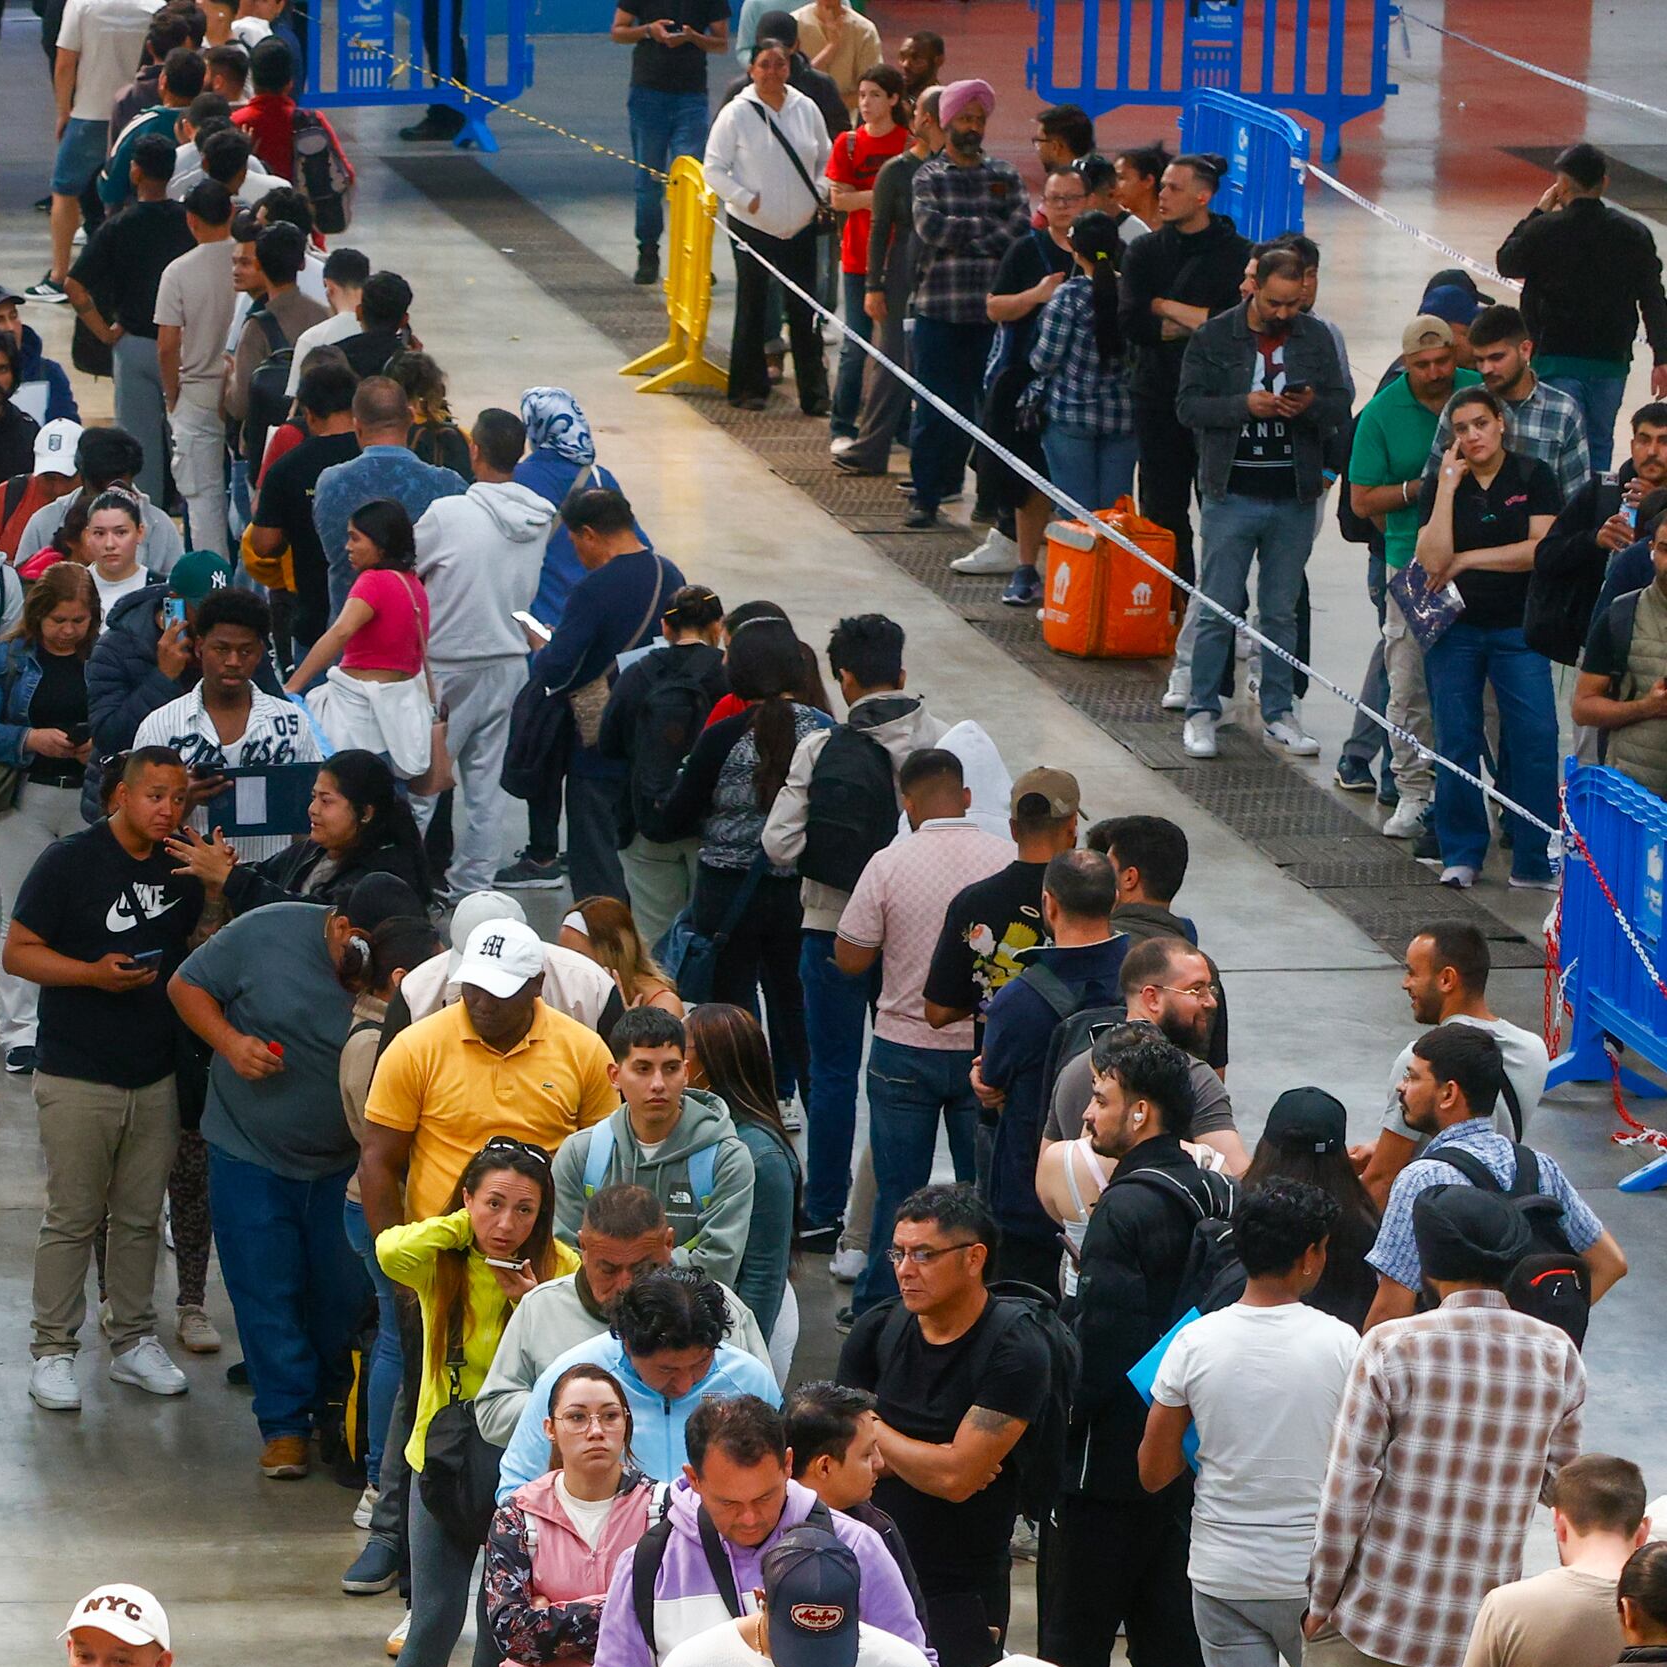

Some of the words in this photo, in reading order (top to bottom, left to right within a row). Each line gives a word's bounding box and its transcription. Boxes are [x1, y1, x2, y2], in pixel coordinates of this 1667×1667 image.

[211, 570, 227, 589] NY
[274, 714, 298, 736] 05
[83, 1595, 143, 1622] NYC
